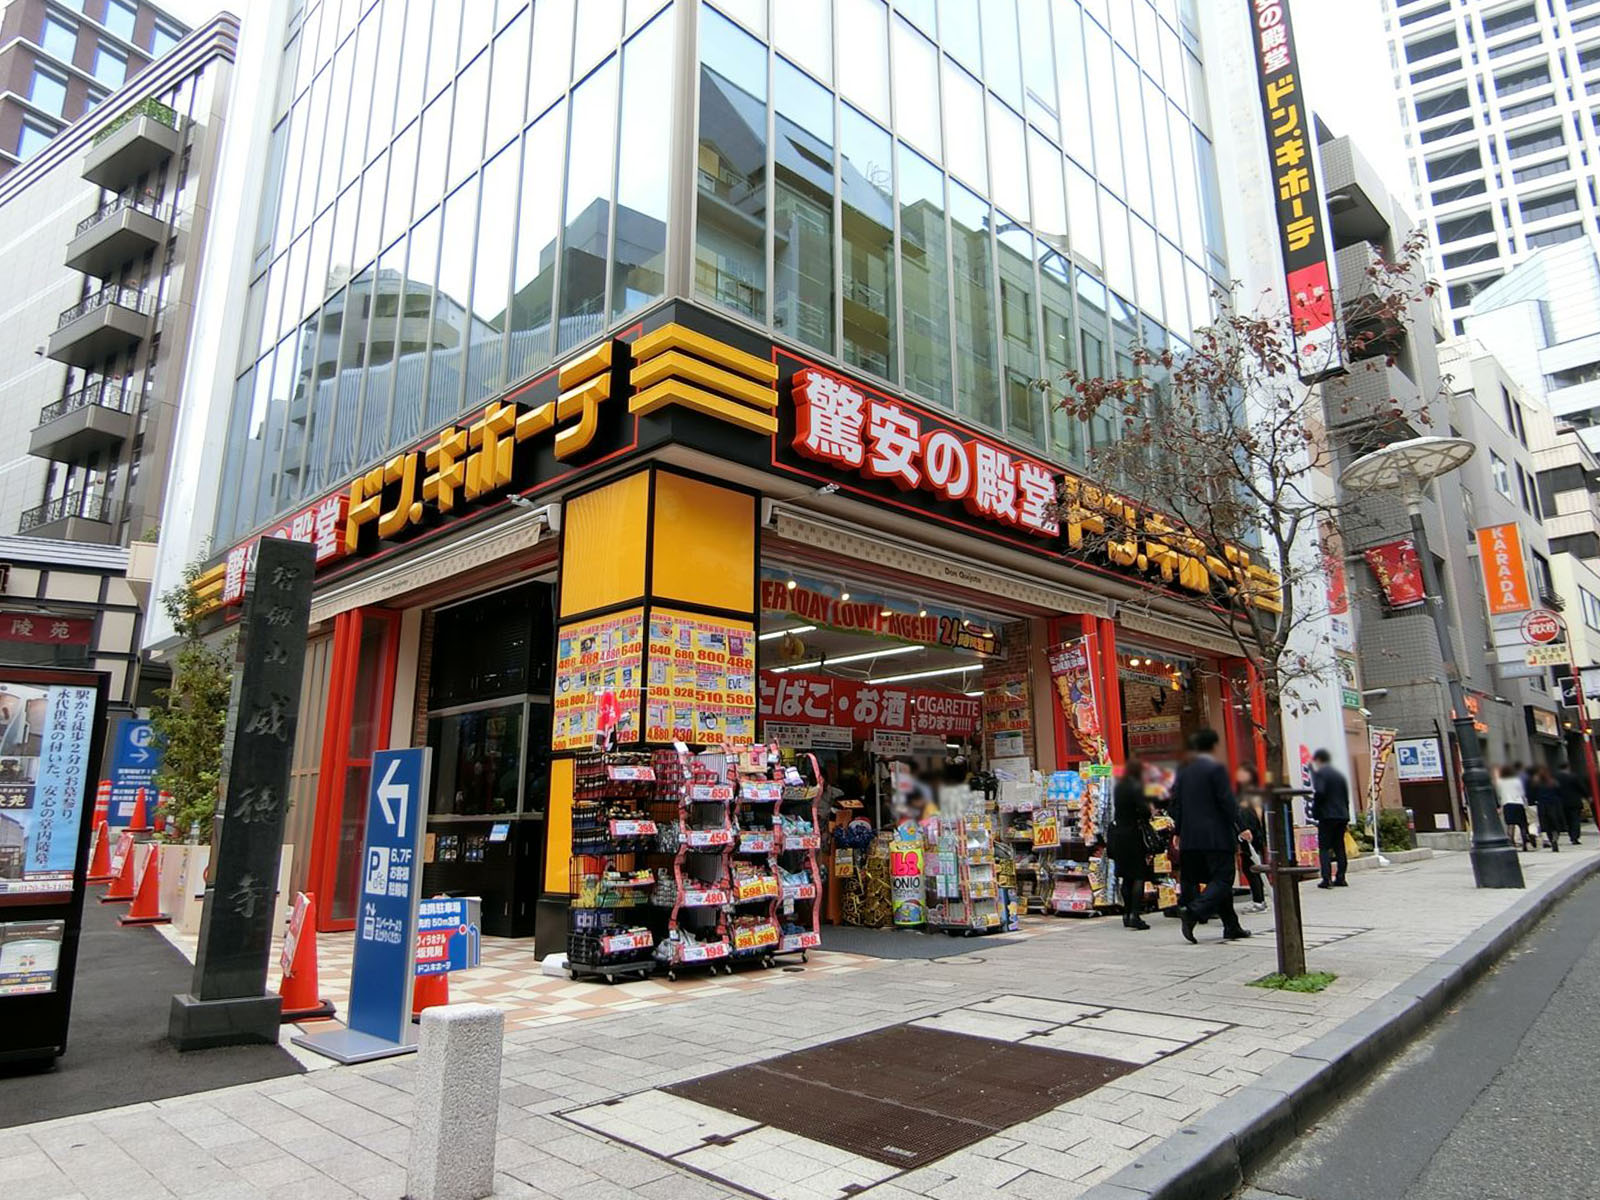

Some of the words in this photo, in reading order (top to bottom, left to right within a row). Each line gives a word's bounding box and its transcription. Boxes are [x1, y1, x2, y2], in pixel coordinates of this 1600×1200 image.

[806, 372, 1060, 533] 驚安の殿堂
[833, 602, 884, 633] LOW
[11, 619, 70, 638] 陵苑
[650, 644, 671, 655] 640
[675, 649, 694, 660] 680
[697, 650, 725, 664] 800
[727, 657, 753, 669] 488
[728, 678, 742, 689] EVE
[674, 687, 694, 698] 928
[696, 690, 723, 704] 510
[726, 693, 754, 705] 580
[916, 695, 980, 717] CIGARETTE
[617, 729, 638, 741] 798
[698, 732, 724, 743] 288
[712, 787, 730, 799] 650
[709, 833, 729, 845] 450
[1037, 827, 1055, 844] 200
[705, 892, 723, 904] 480
[742, 887, 763, 898] 598
[633, 934, 652, 948] 147
[704, 946, 724, 958] 198
